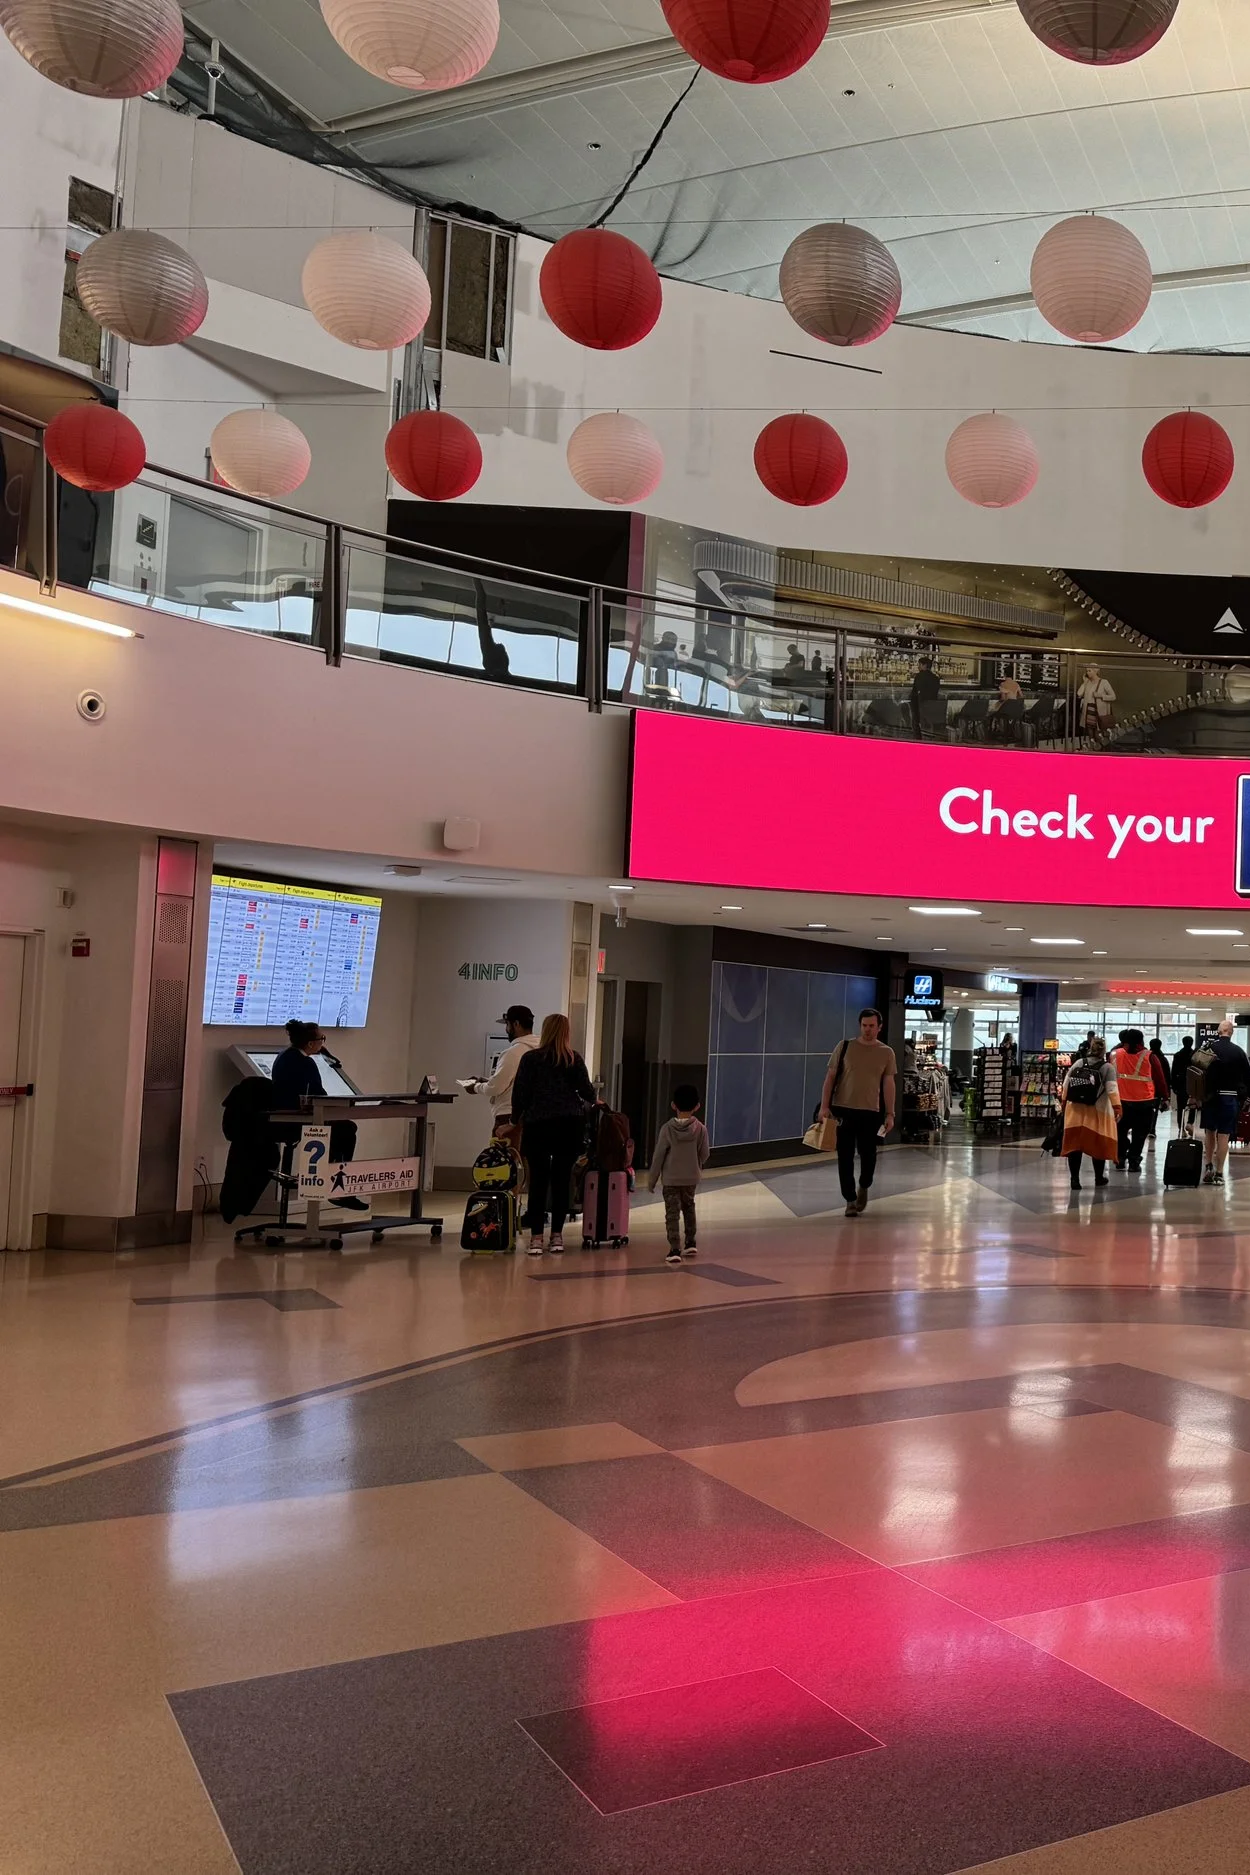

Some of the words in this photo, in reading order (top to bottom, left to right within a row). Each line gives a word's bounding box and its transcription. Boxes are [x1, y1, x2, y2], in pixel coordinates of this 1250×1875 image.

[939, 786, 1095, 840] Check
[1107, 814, 1215, 859] your
[904, 995, 941, 1005] Hudson
[301, 1175, 324, 1187] info
[345, 1171, 396, 1185] TRAVELERS
[399, 1169, 414, 1179] AID
[347, 1185, 364, 1193] JFK
[371, 1179, 411, 1189] AIRPORT
